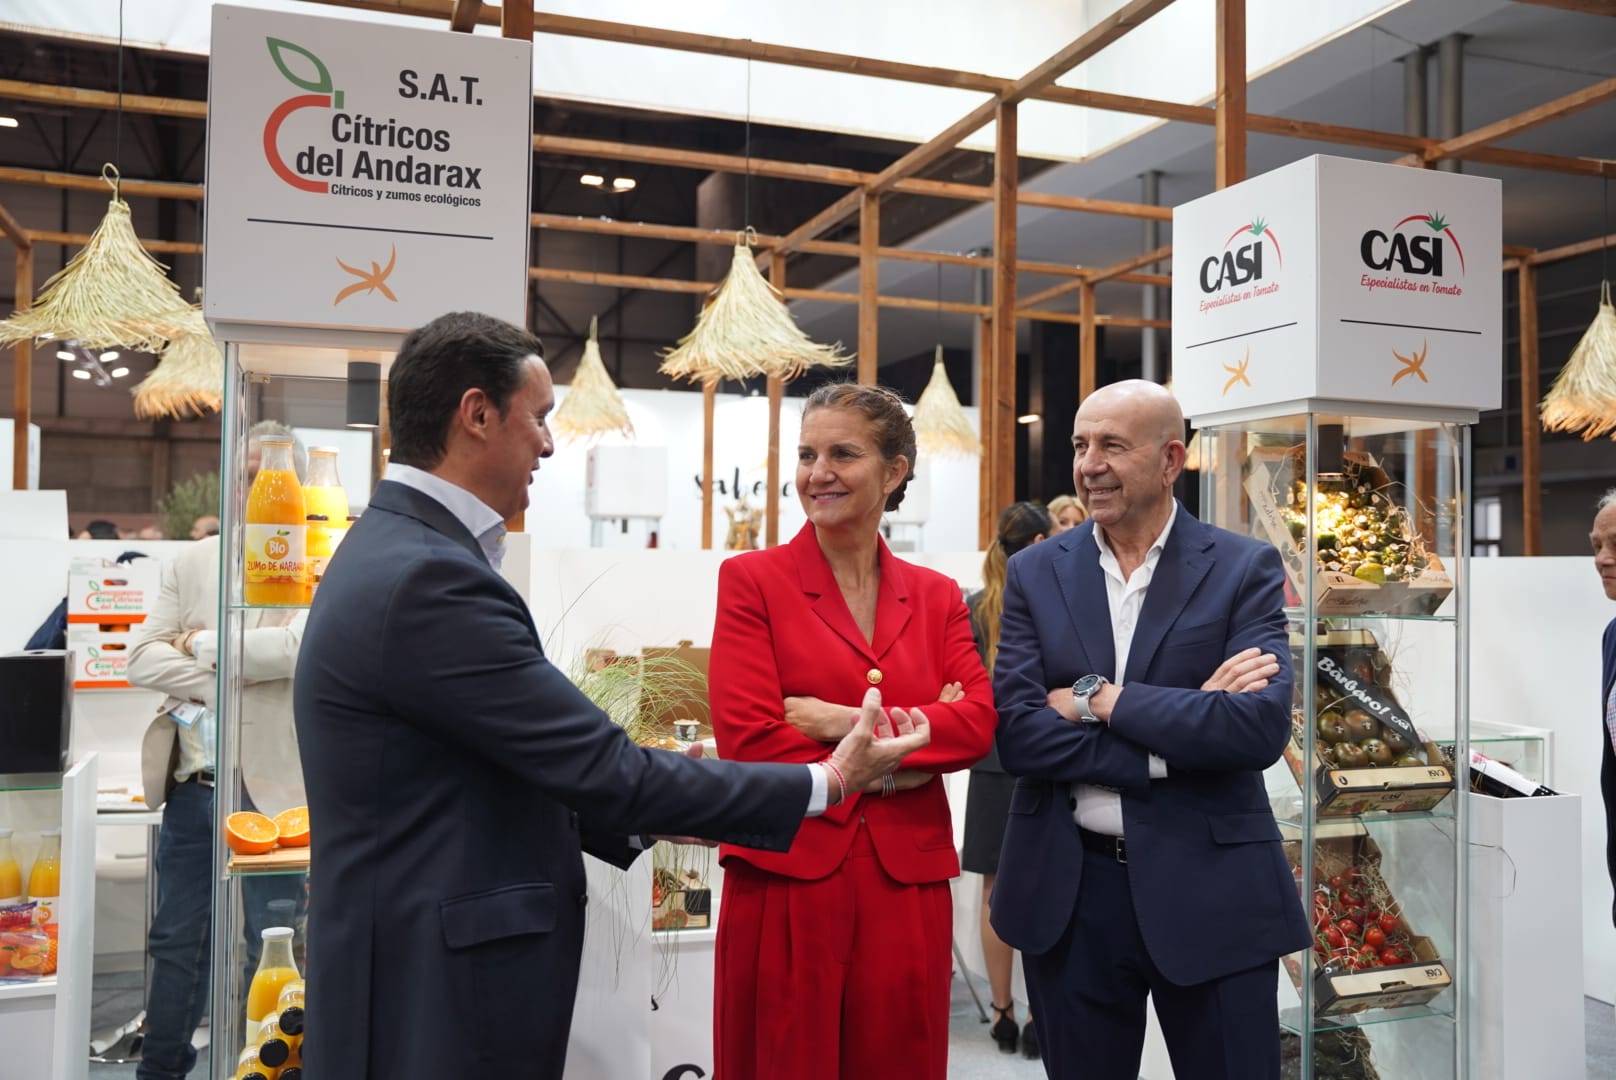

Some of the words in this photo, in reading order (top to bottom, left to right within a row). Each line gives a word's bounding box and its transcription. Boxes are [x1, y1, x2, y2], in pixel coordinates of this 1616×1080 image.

[398, 69, 483, 106] S.A.T.
[331, 112, 450, 152] Cítricos
[296, 145, 343, 177] del
[352, 150, 482, 190] Andarax
[331, 183, 374, 198] Cítricos
[376, 189, 383, 200] y
[385, 190, 421, 202] zumos
[424, 193, 481, 207] ecológicos
[1200, 240, 1262, 294] CASI
[1361, 229, 1443, 277] CASI
[1200, 292, 1241, 315] Especialistas
[1242, 291, 1252, 300] en
[1253, 281, 1280, 298] Tomate
[1360, 274, 1418, 292] Especialistas
[1419, 283, 1430, 293] en
[1431, 281, 1463, 296] Tomate
[268, 561, 277, 571] DE
